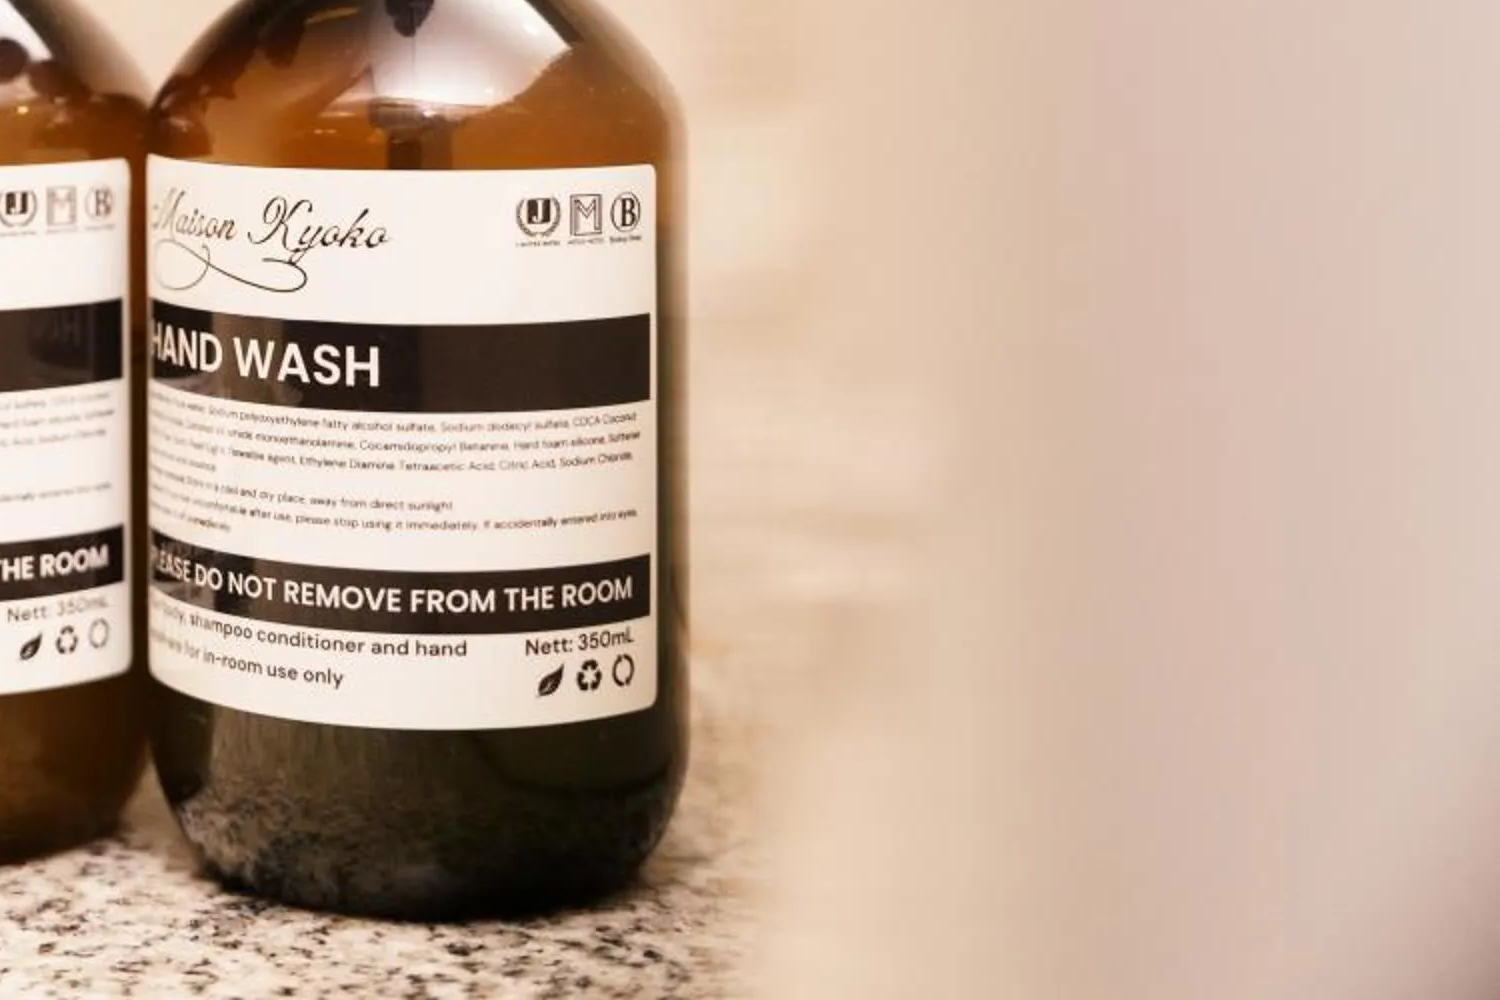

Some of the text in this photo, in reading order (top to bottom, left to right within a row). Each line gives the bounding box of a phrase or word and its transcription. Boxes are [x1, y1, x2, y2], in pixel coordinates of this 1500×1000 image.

[152, 187, 393, 275] Maison Kyoko
[151, 320, 381, 387] HAND WASH
[40, 544, 110, 578] ROOM
[155, 550, 633, 613] LEASE DO NOT REMOVE FROM THE ROOM
[189, 611, 253, 640] shampoo
[257, 630, 364, 654] conditioner
[371, 639, 409, 656] and
[415, 639, 468, 657] hand
[525, 626, 635, 656] Nett: 350mL
[203, 649, 263, 675] in-room
[267, 663, 299, 681] use
[303, 667, 344, 690] only
